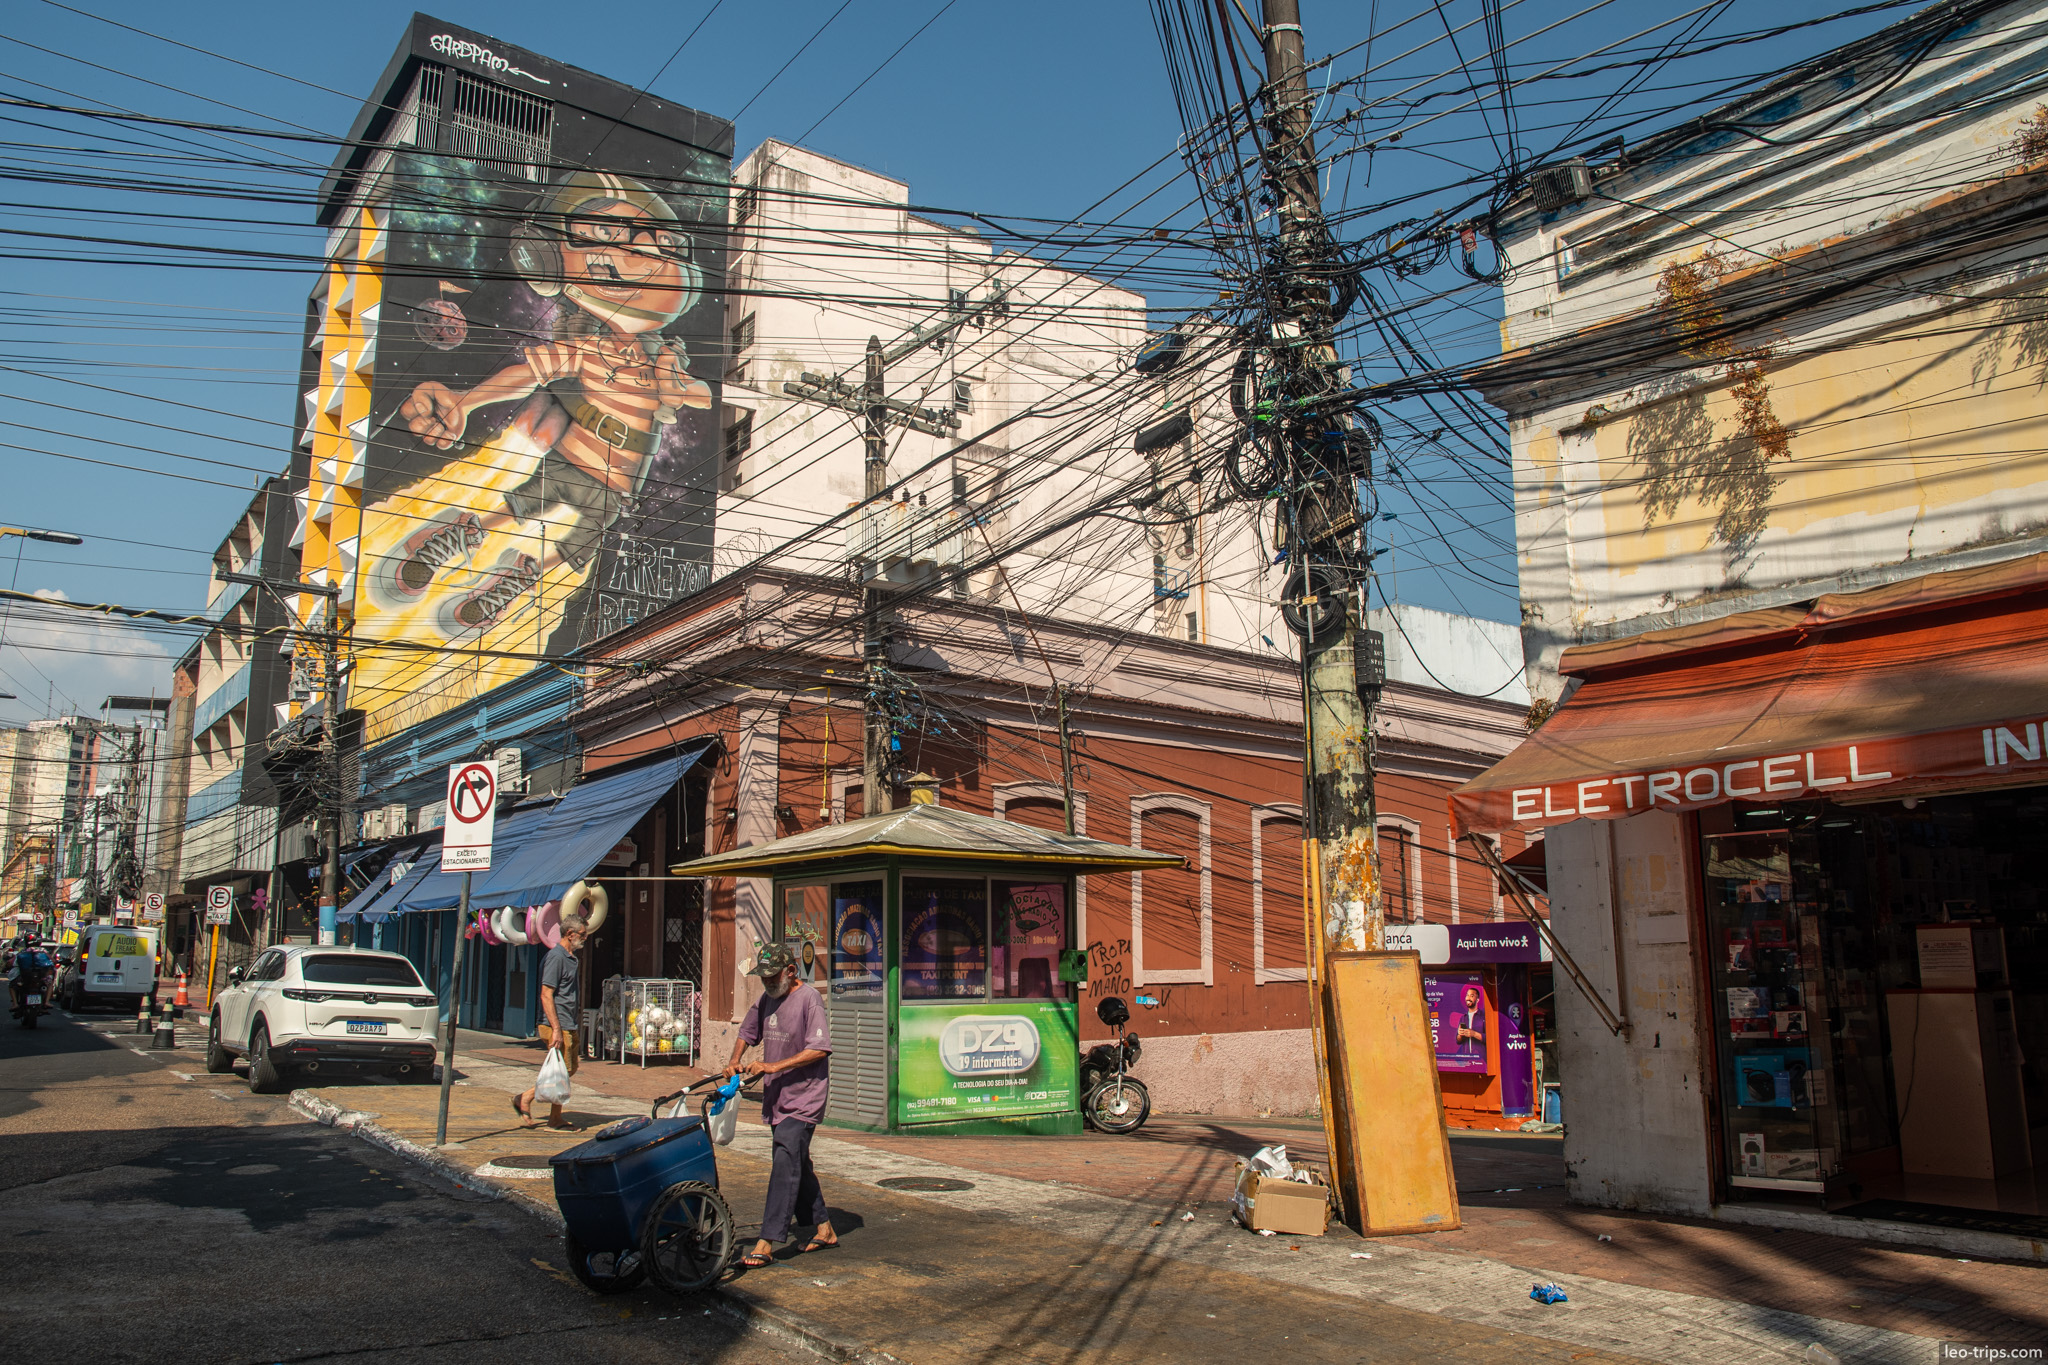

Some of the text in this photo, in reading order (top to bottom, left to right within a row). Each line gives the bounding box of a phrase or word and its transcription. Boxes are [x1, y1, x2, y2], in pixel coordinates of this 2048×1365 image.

[609, 539, 675, 598] ARE
[1512, 746, 1892, 821] ELETROCELL
[456, 849, 478, 857] EXCETO
[443, 857, 490, 865] ESTACIONAMENTO
[788, 912, 824, 931] TAXI
[116, 936, 137, 945] AUDIO
[1385, 934, 1412, 944] anca
[1456, 936, 1520, 950] Aqui tem vivo
[1102, 961, 1122, 976] DO
[1089, 975, 1130, 998] MANO
[958, 1023, 1023, 1054] DZ9
[1507, 1040, 1527, 1050] vivo
[972, 1055, 1023, 1069] informática
[957, 1080, 987, 1088] TECNOLOGIA
[987, 1079, 994, 1087] DO
[995, 1079, 1004, 1087] SEU
[1030, 1090, 1047, 1100] DZ9
